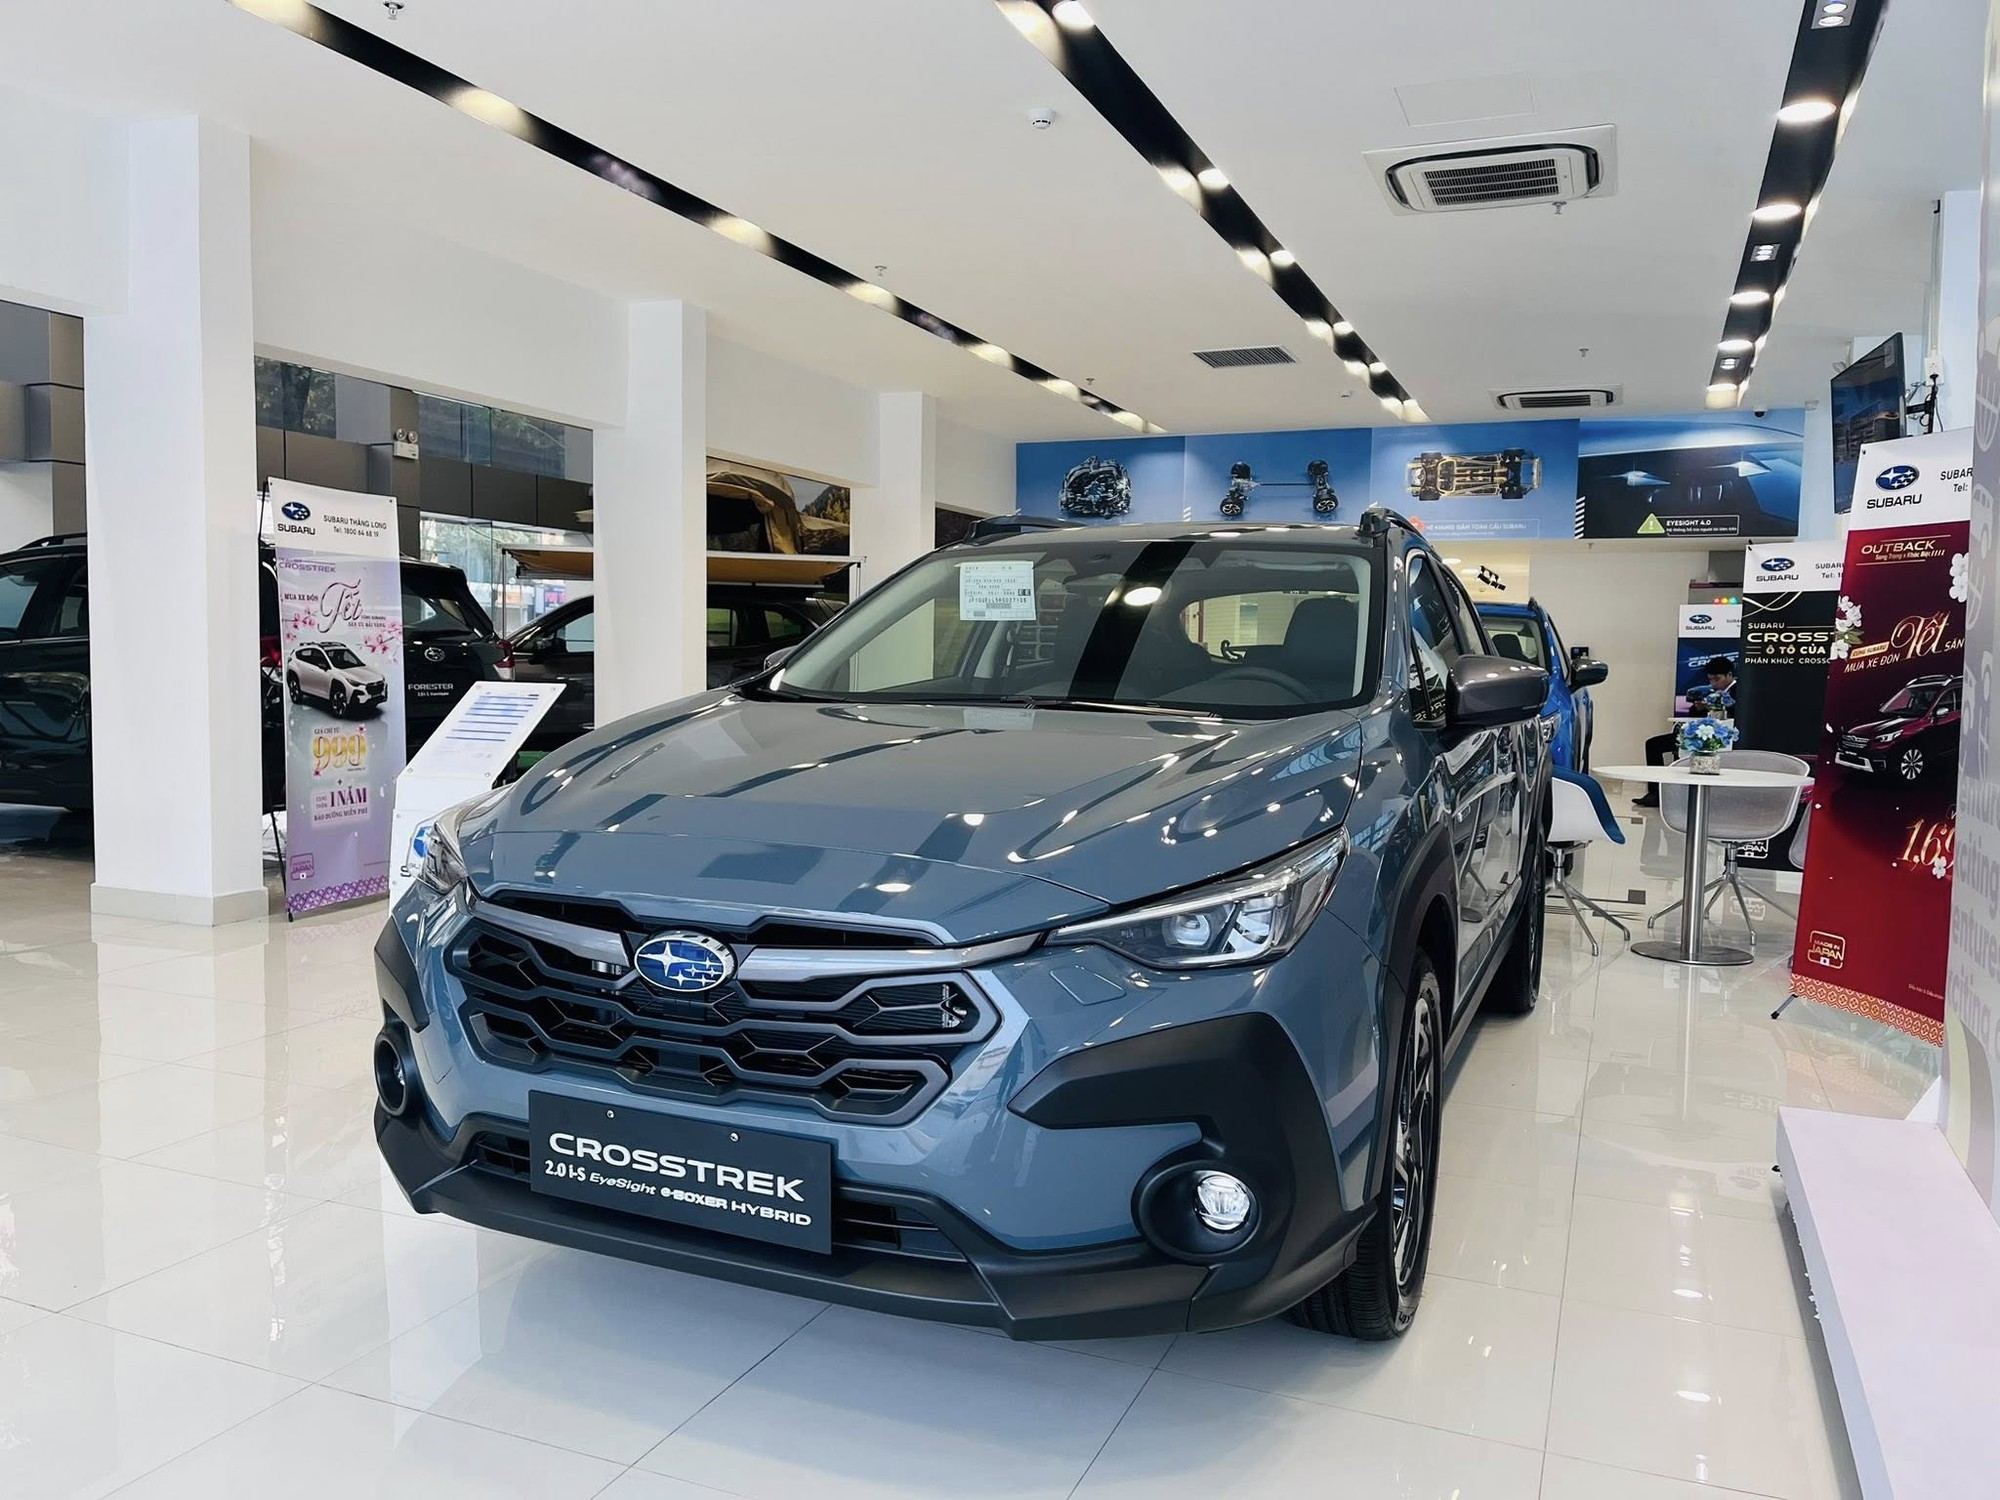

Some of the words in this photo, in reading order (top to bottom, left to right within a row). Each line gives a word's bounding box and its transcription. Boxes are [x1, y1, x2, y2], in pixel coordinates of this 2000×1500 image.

[1940, 467, 1973, 480] SUBAR
[1953, 482, 1968, 492] Tel:
[1866, 494, 1922, 509] SUBARU
[323, 515, 348, 525] SUBARU
[371, 521, 387, 529] LONG
[277, 523, 316, 535] SUBARU
[1861, 540, 1936, 554] OUTBACK
[279, 562, 336, 573] CROSSTREK
[1815, 562, 1845, 570] SUBAR
[1766, 644, 1775, 654] Ô
[1779, 644, 1796, 654] TÔ
[1800, 643, 1826, 654] CỦA
[1744, 656, 1768, 664] PHÂN
[1771, 656, 1794, 664] KHÚC
[1843, 660, 1865, 673] MUA
[1866, 657, 1880, 669] XE
[1814, 940, 1832, 949] MADE
[1811, 944, 1844, 960] JAPAN
[549, 1132, 805, 1202] CROSSTREK
[544, 1160, 567, 1178] 2.0
[568, 1164, 587, 1182] i-S
[589, 1172, 657, 1195] EyeSight
[660, 1187, 728, 1210] e-BOXER
[731, 1200, 813, 1226] HYBRID
